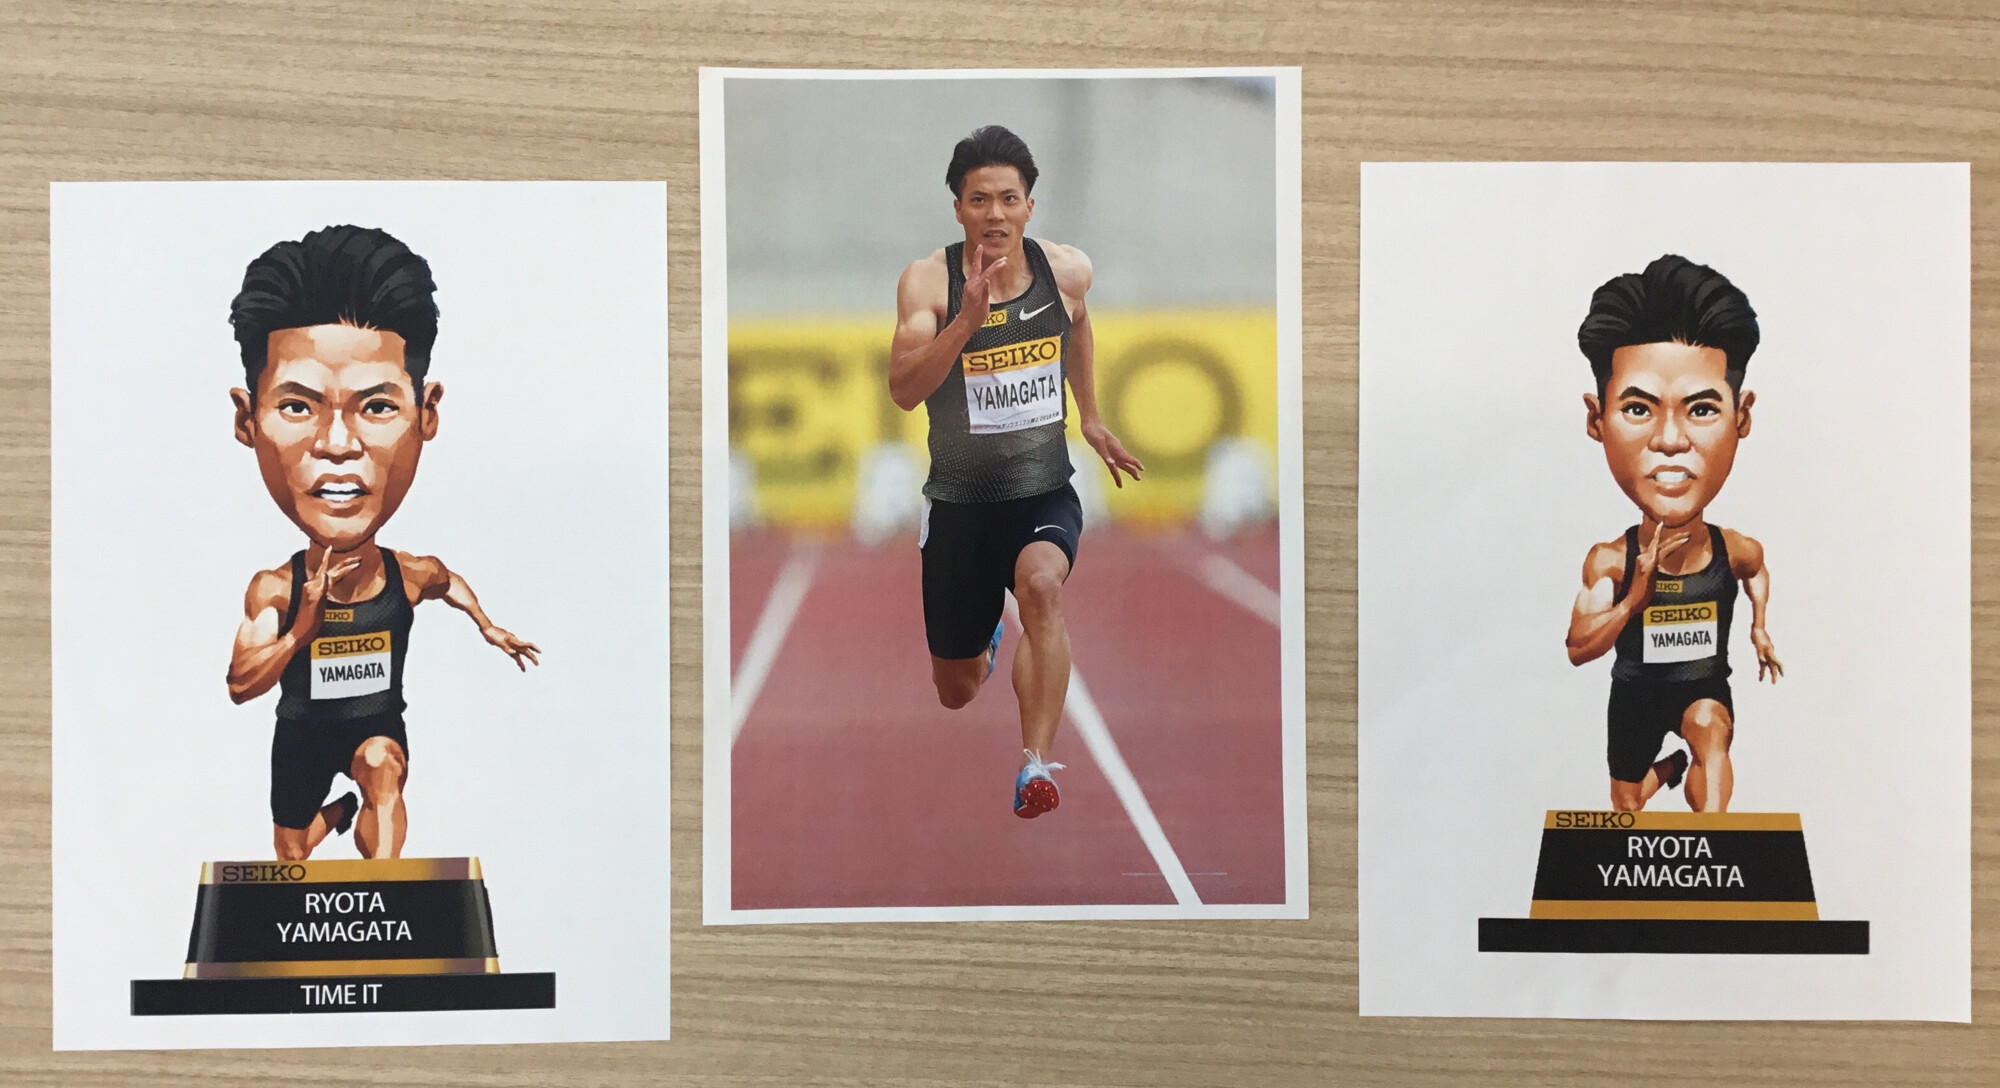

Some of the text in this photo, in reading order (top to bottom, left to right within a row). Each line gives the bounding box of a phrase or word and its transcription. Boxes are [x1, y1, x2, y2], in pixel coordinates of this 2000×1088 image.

[968, 341, 1057, 373] SEIKO
[973, 374, 1058, 411] YAMAGATA
[1650, 607, 1712, 623] SEIKO
[318, 637, 386, 656] SEIKO
[1651, 630, 1712, 648] YAMAGATA
[319, 662, 386, 683] YAMAGATA
[1555, 811, 1636, 829] SEIKO
[1627, 836, 1713, 859] RYOTA
[222, 864, 307, 882] SEIKO
[1597, 864, 1745, 888] YAMAGATA
[304, 891, 386, 914] RYOTA
[276, 920, 413, 943] YAMAGATA
[300, 983, 383, 1006] TIME IT
